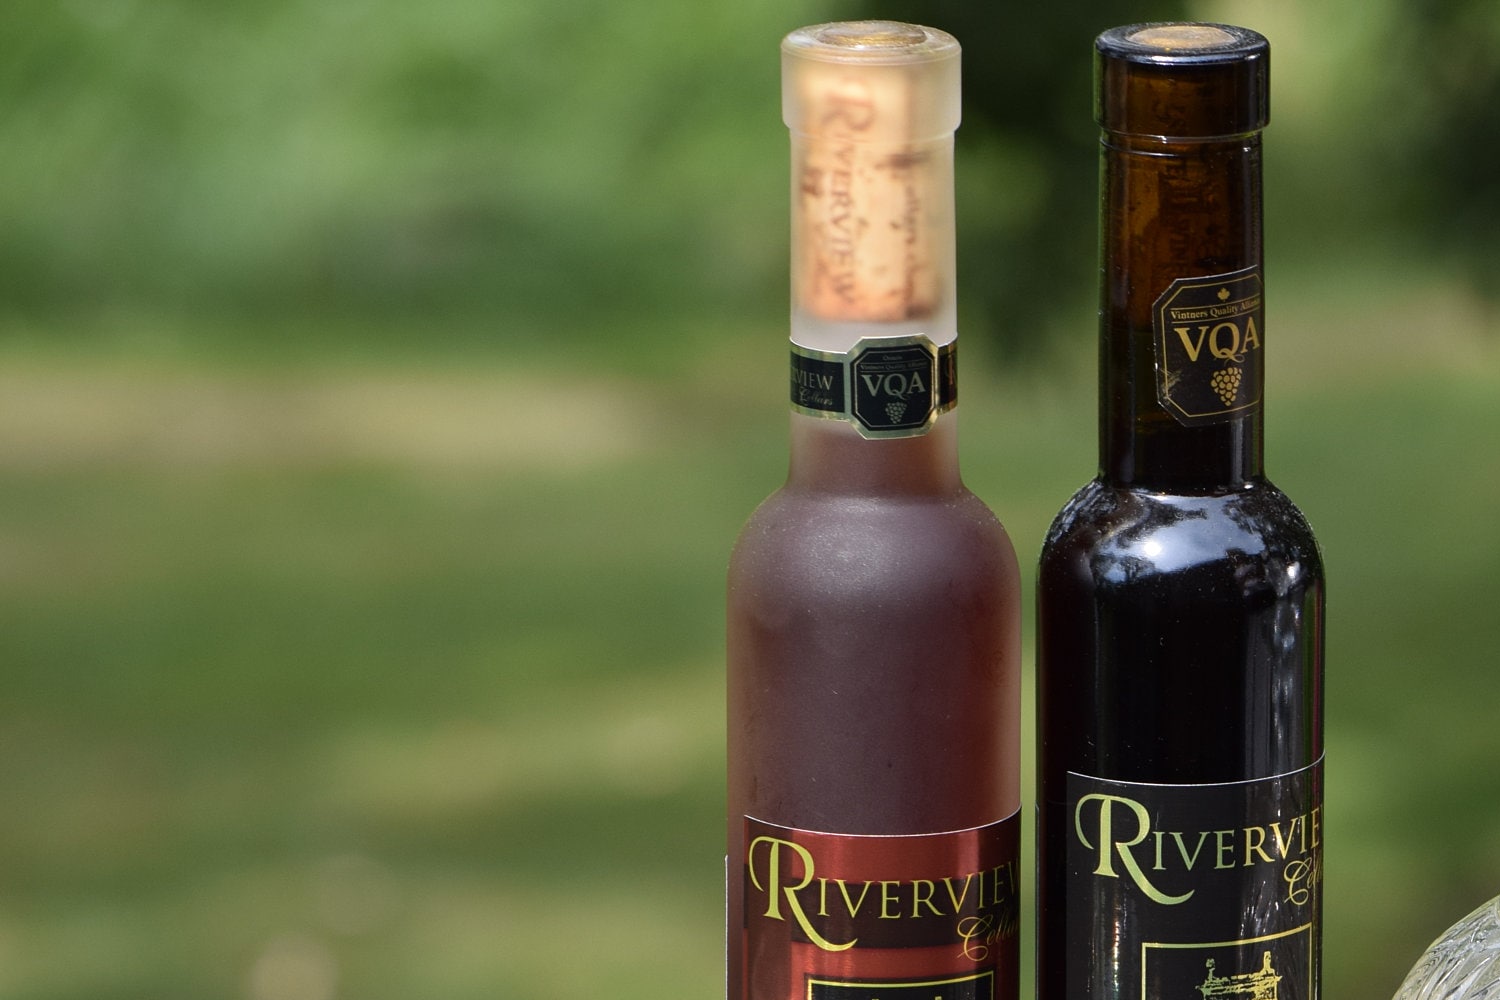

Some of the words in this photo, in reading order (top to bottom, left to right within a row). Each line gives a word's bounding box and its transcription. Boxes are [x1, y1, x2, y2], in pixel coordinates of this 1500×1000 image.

[1170, 308, 1208, 320] Vintners
[1210, 303, 1238, 318] Quality
[1174, 316, 1260, 363] VQA
[861, 371, 926, 400] VQA
[1075, 793, 1323, 905] RIVERVIE
